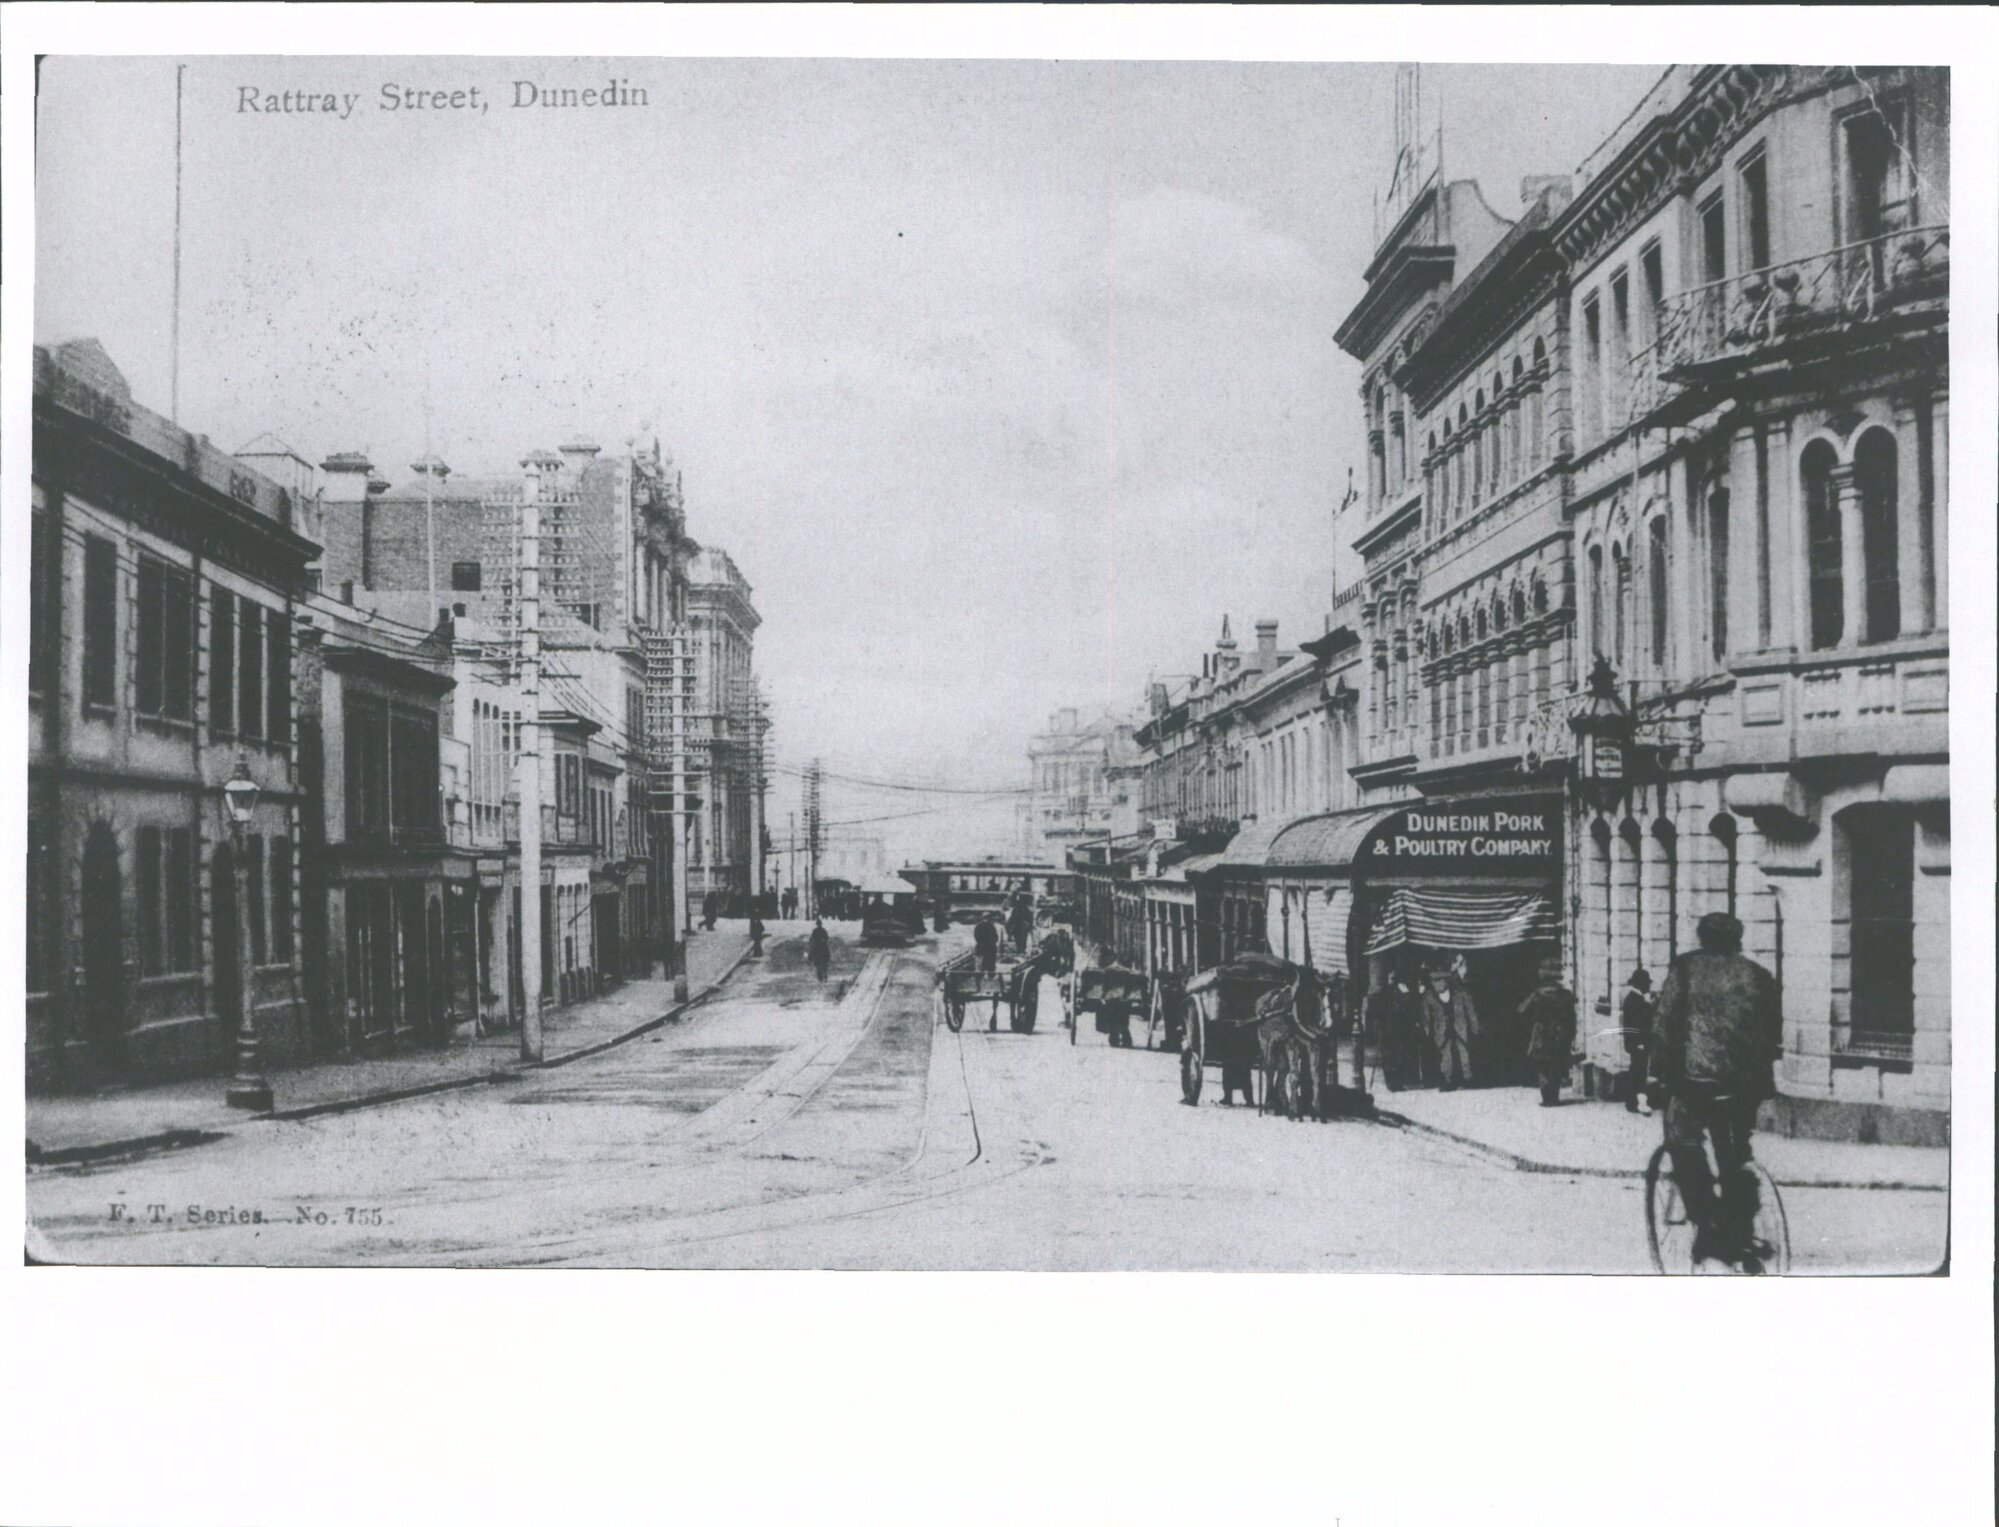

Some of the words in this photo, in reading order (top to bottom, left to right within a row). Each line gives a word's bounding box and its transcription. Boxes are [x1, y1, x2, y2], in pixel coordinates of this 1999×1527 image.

[1407, 813, 1489, 832] DUNEDIN
[1494, 812, 1545, 831] PORK
[1372, 839, 1389, 855] &
[1395, 836, 1468, 856] POULTRY
